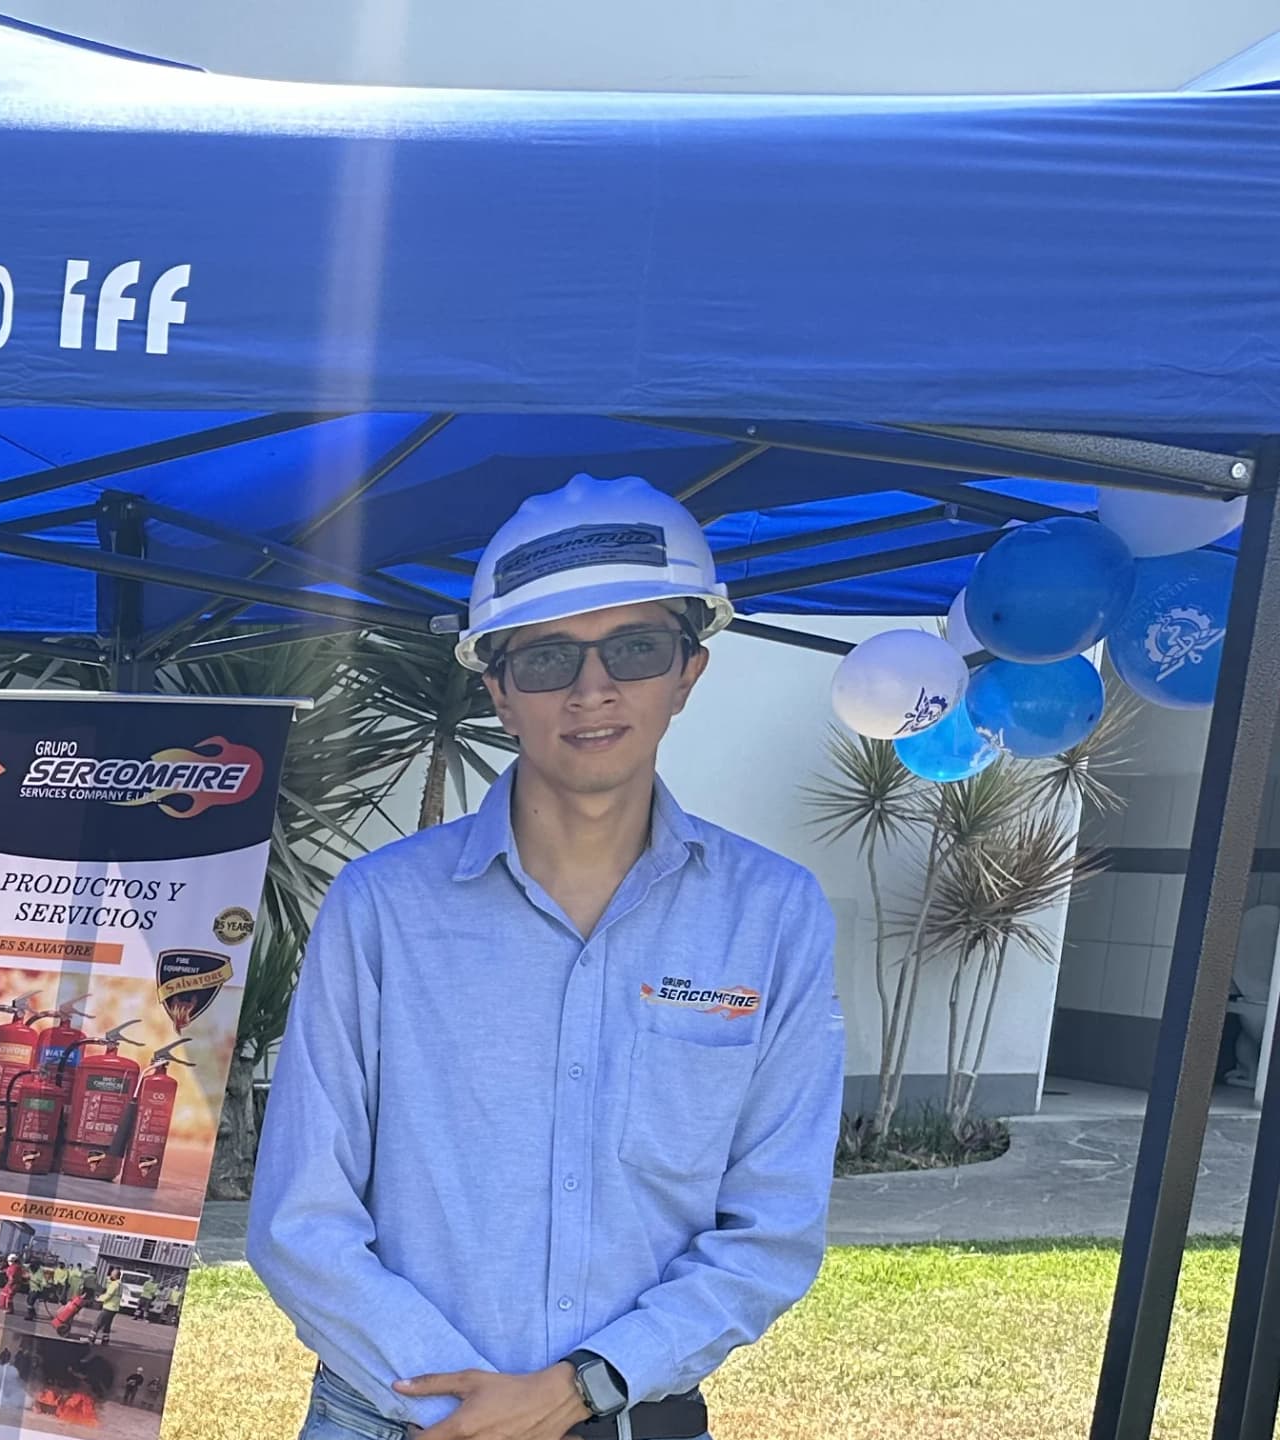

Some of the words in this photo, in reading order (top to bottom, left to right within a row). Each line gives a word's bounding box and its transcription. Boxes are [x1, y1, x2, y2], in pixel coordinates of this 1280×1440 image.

[35, 741, 78, 756] GRUPO
[23, 757, 250, 793] SERCOMFIRE
[20, 787, 67, 799] SERVICES
[69, 789, 124, 801] COMPANY
[0, 872, 160, 900] PRODUCTOS
[167, 882, 186, 901] Y
[15, 902, 157, 930] SERVICIOS
[227, 921, 254, 932] YEARS
[17, 939, 93, 957] SALVATORE
[662, 977, 691, 988] GRUPO
[658, 988, 759, 1007] SERCOMFIRE
[10, 1201, 126, 1227] CAPACITACIONES
